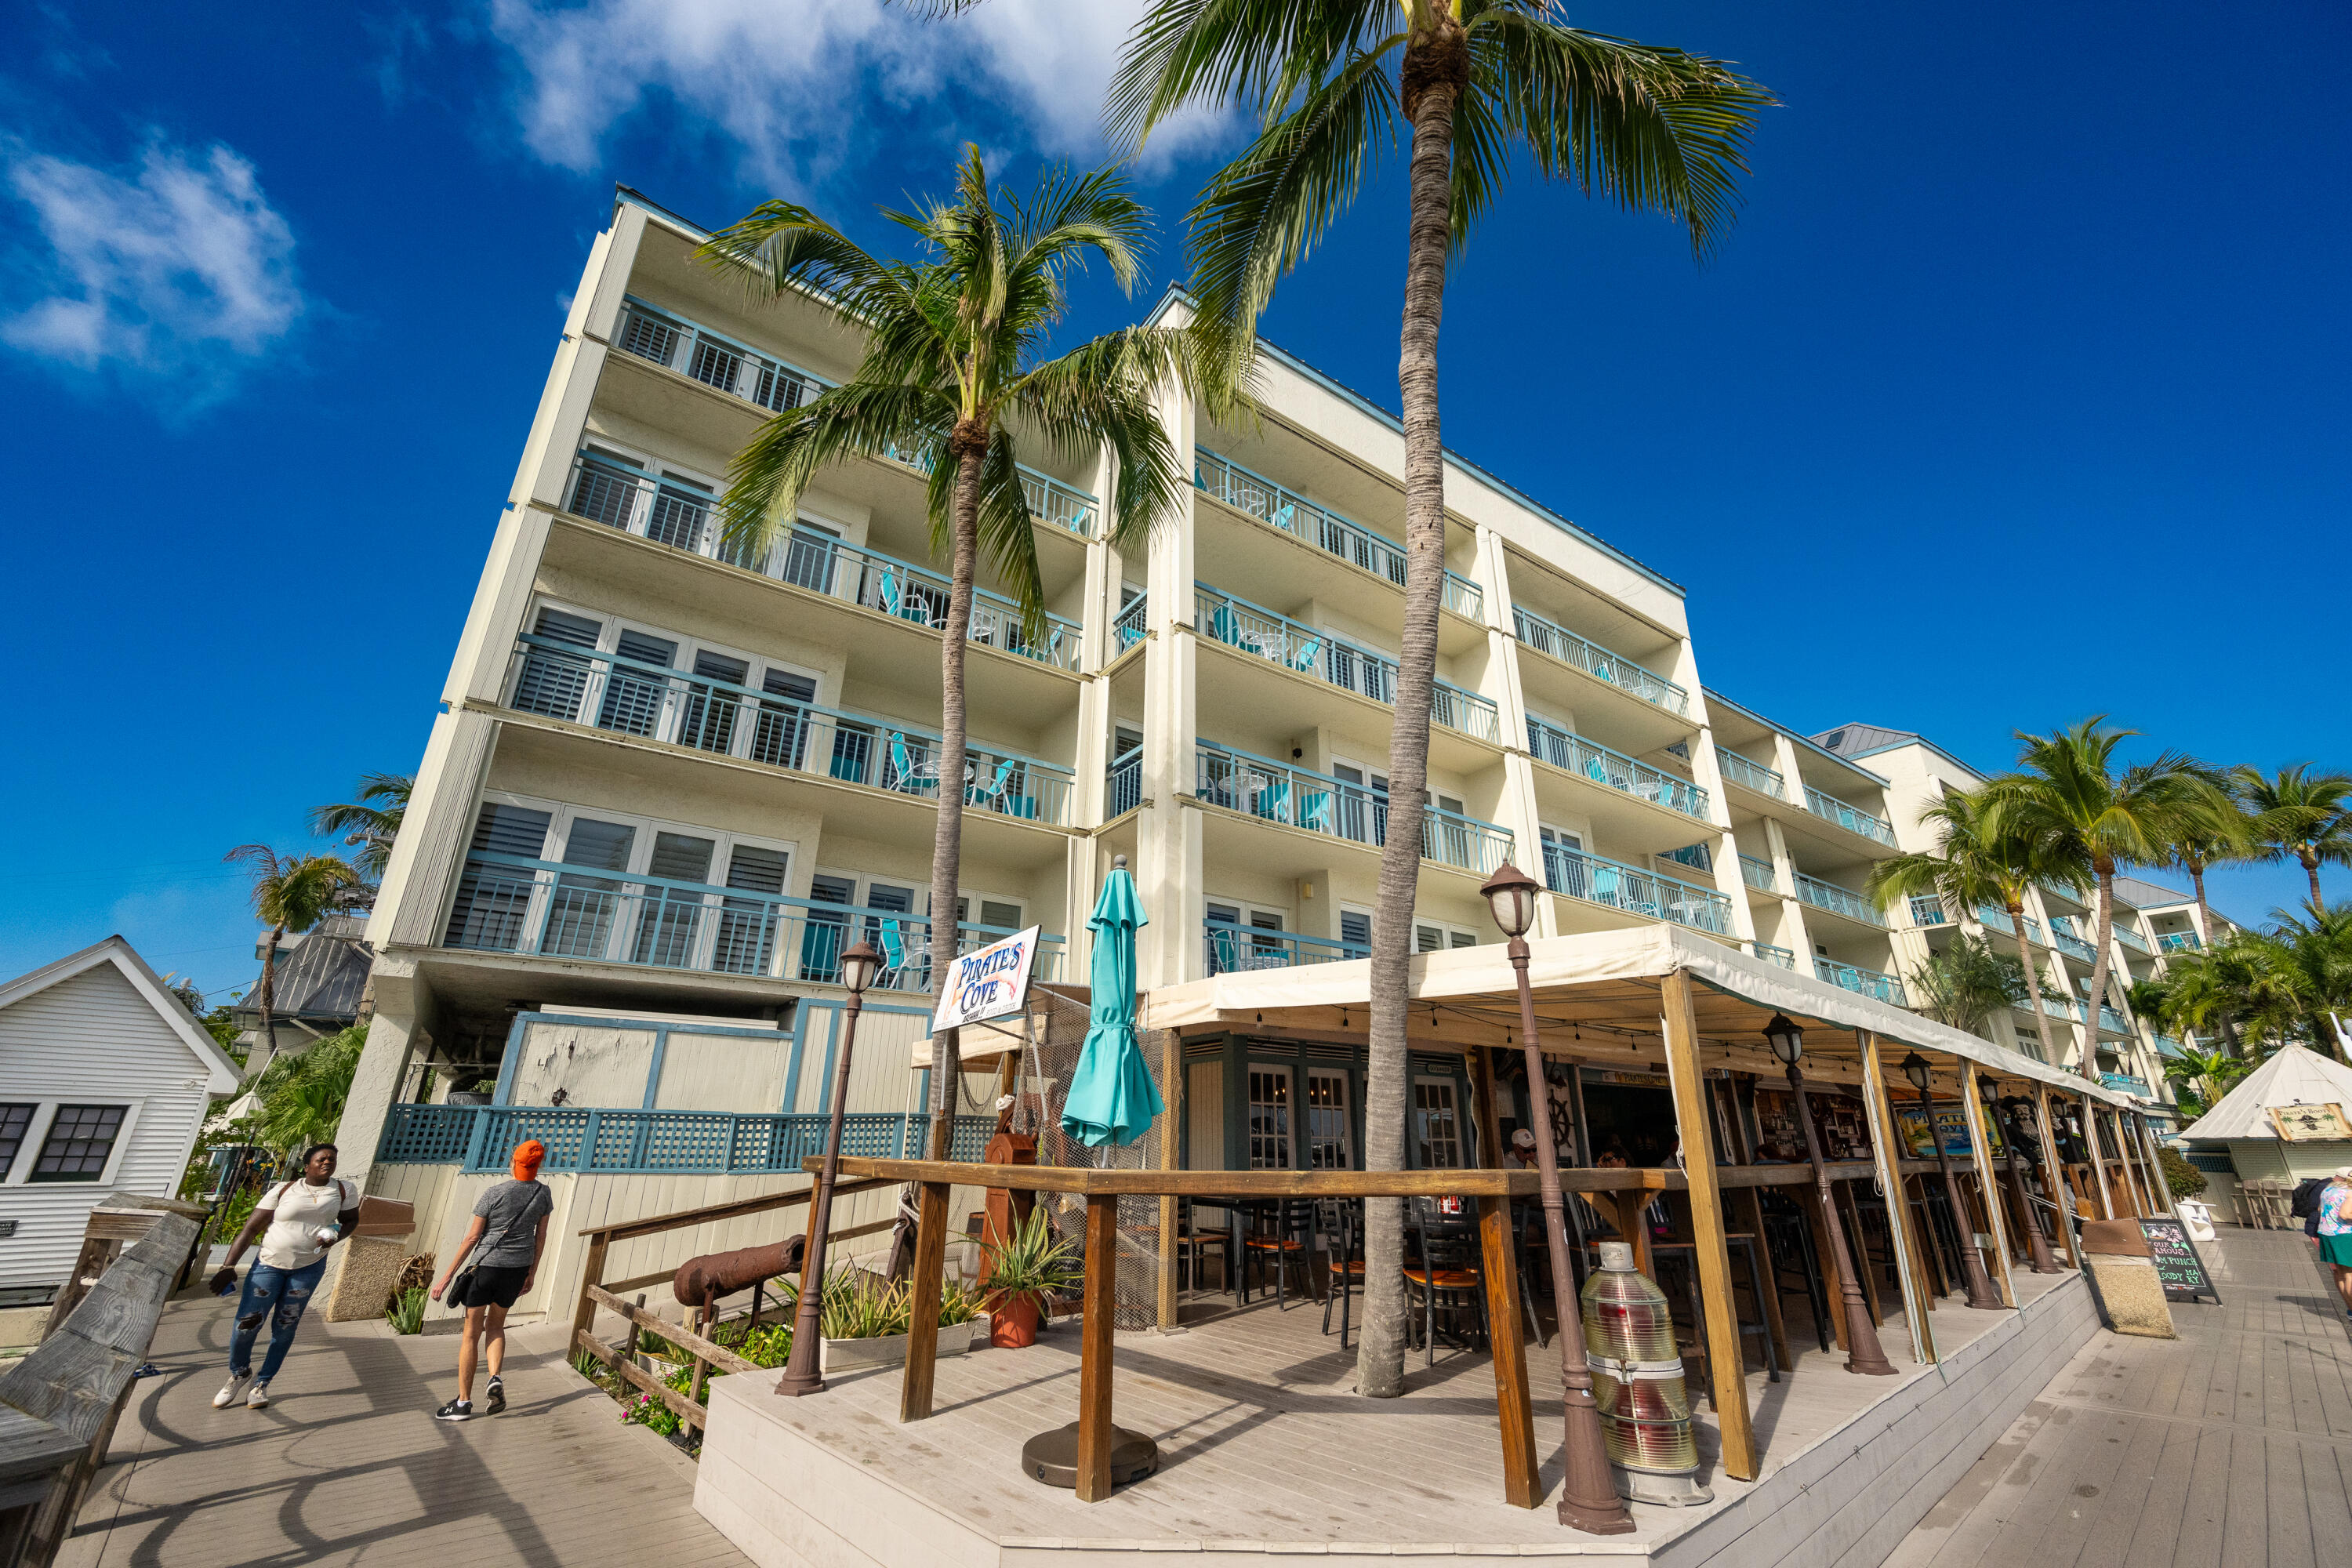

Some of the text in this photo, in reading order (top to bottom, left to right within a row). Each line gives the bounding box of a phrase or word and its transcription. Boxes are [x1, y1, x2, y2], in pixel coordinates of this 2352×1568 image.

[956, 942, 1022, 989] PIRATE'S
[960, 980, 999, 1014] COVE
[2159, 1272, 2183, 1281] LOODY
